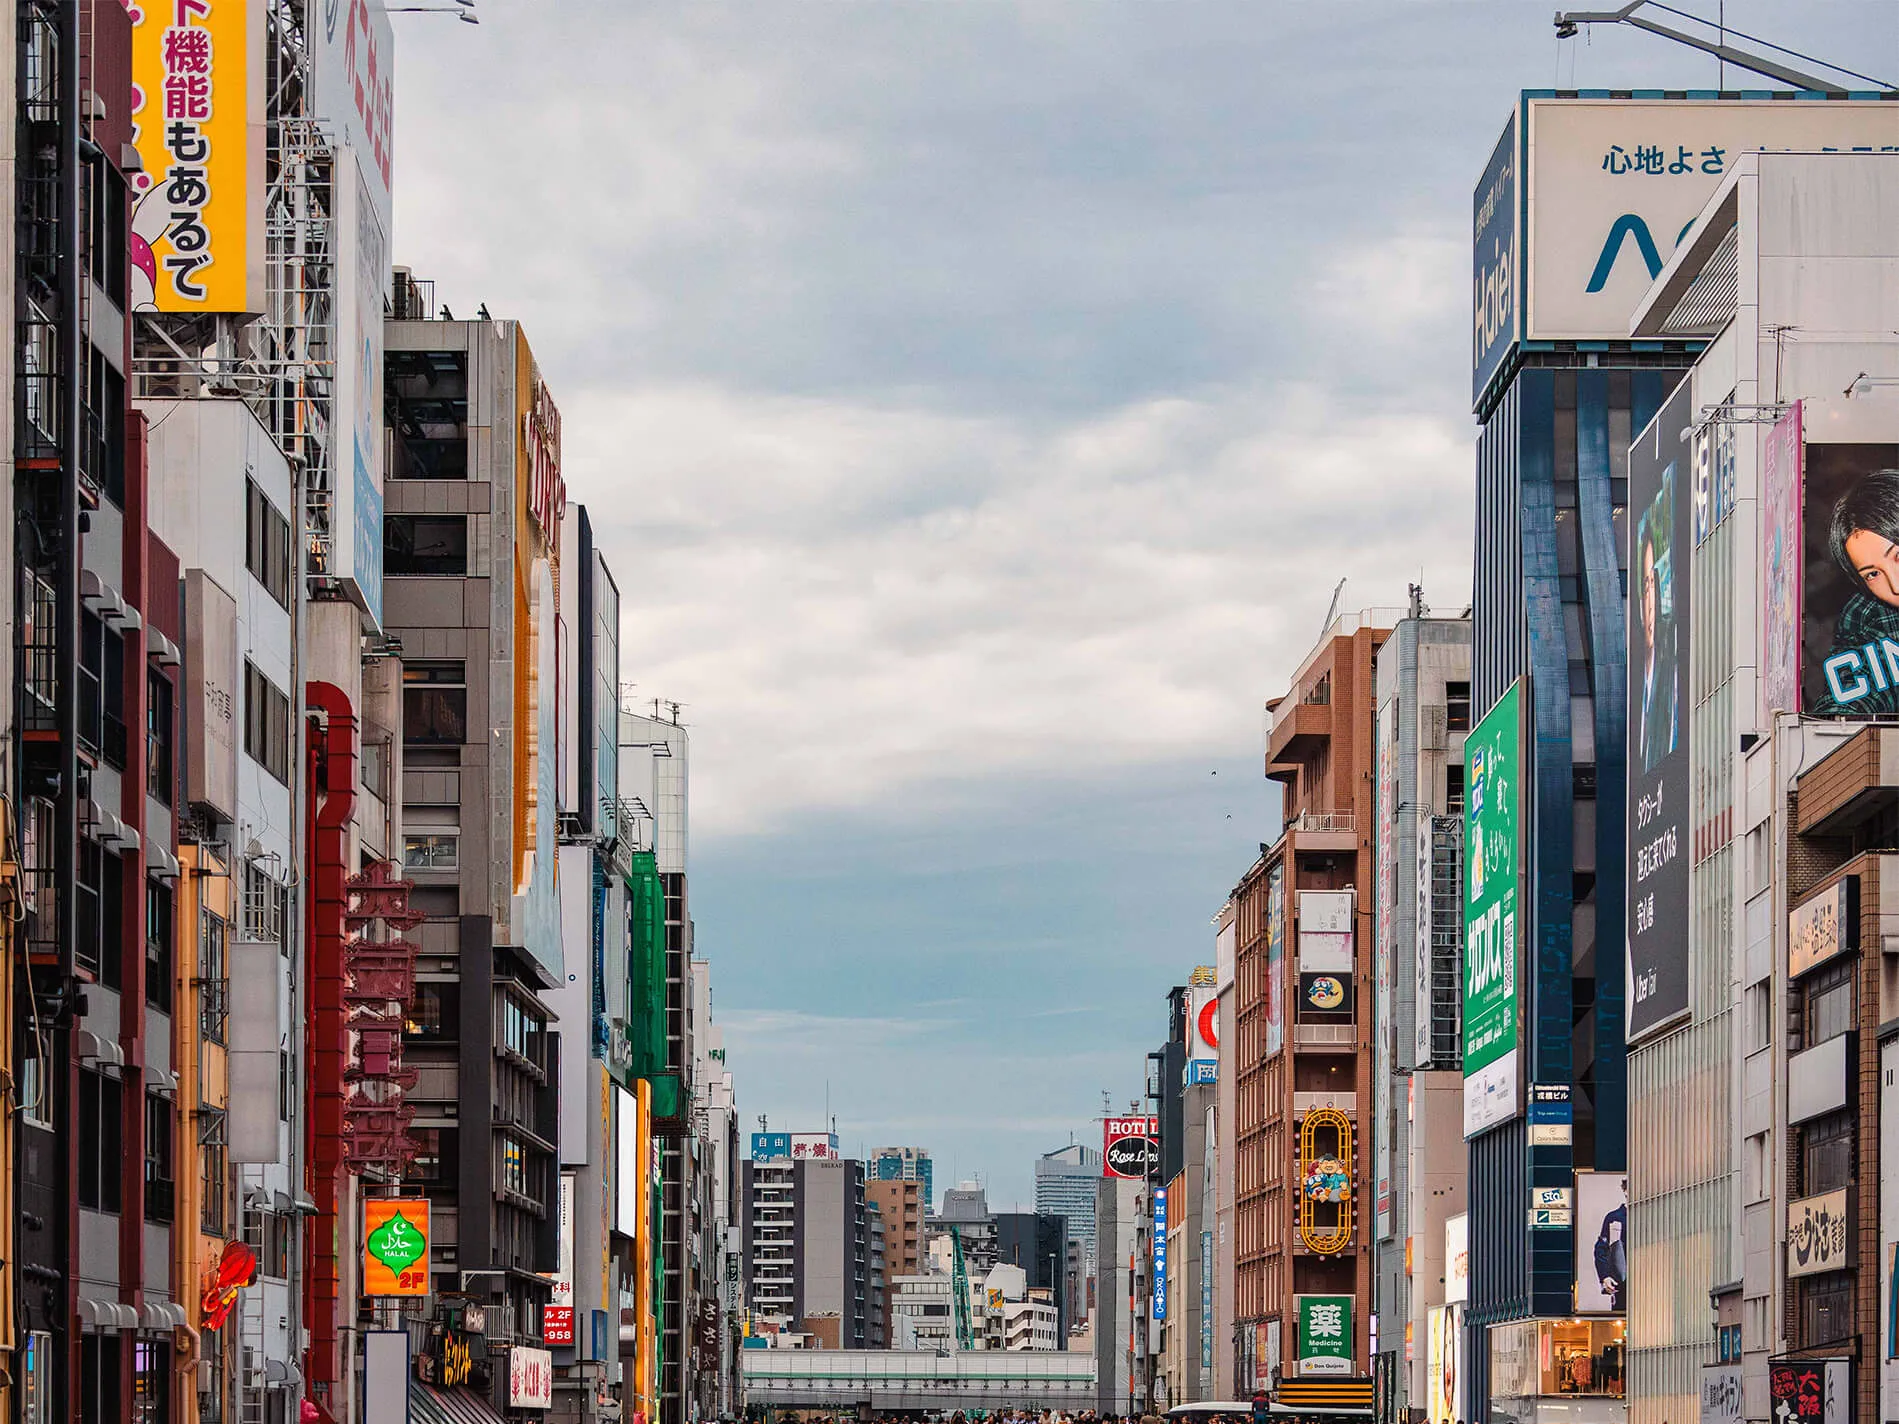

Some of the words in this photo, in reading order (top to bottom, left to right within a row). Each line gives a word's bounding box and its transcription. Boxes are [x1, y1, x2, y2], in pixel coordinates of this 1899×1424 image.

[1602, 144, 1726, 175] 心地よさ
[1474, 232, 1513, 370] Haier
[1468, 901, 1502, 999] サロンパス
[1109, 1149, 1135, 1164] Rose
[381, 1233, 412, 1250] حلال
[399, 1272, 425, 1289] 2F
[558, 1310, 572, 1320] 2F
[1309, 1304, 1343, 1338] 薬
[1308, 1339, 1343, 1347] Medicine
[1798, 1369, 1821, 1416] 大阪
